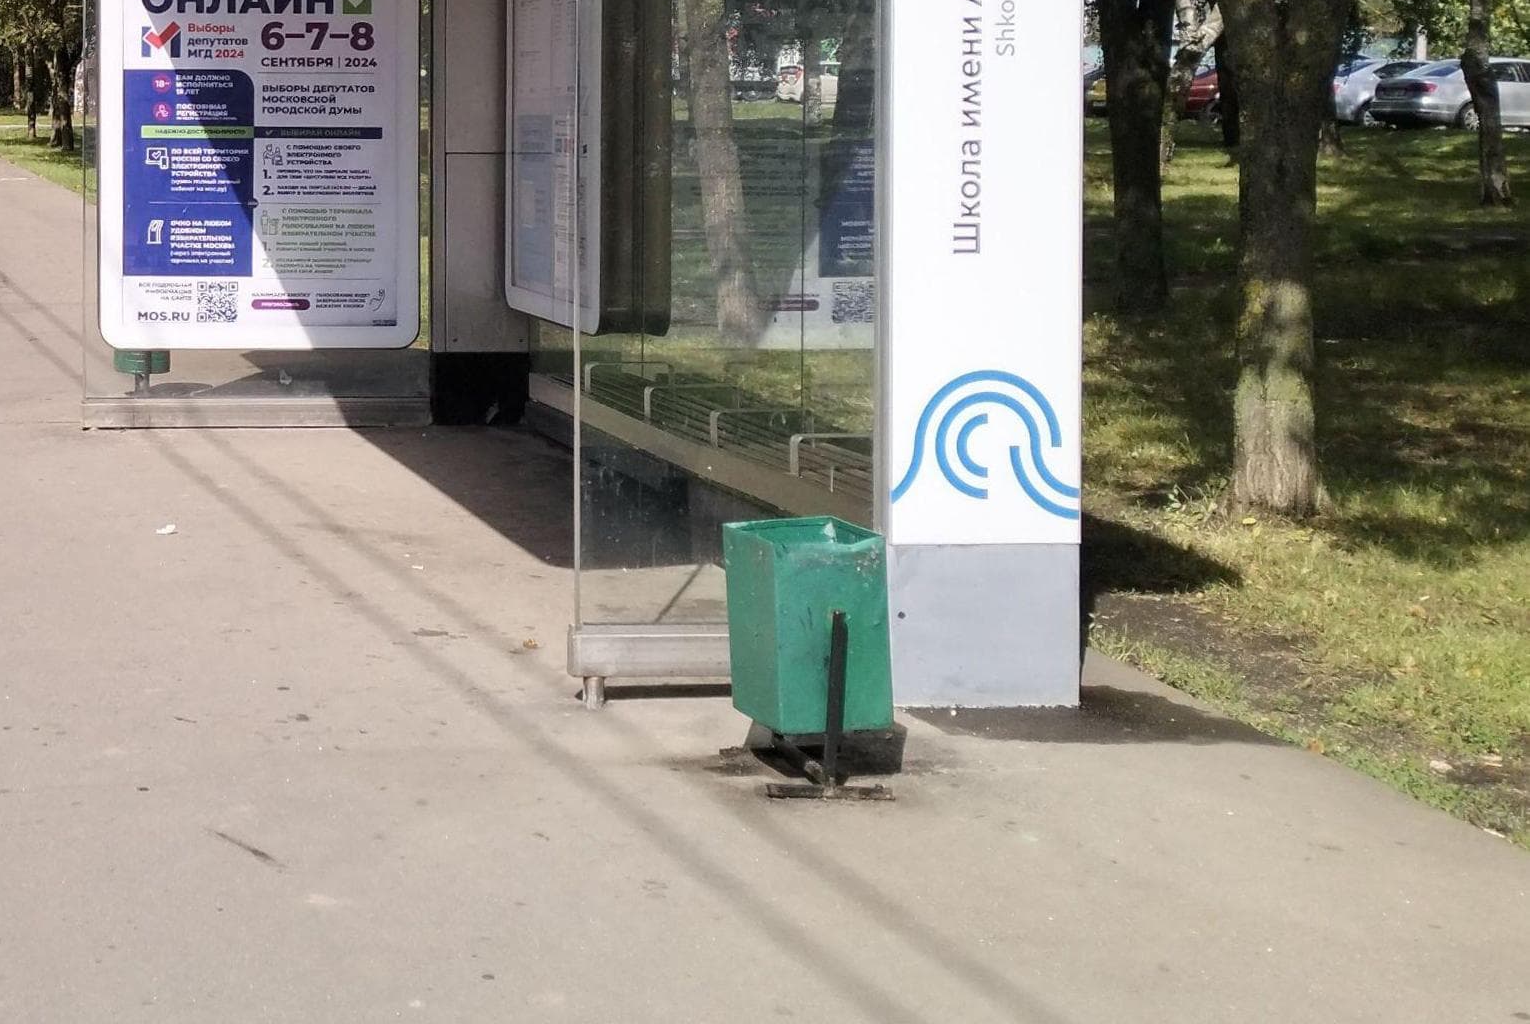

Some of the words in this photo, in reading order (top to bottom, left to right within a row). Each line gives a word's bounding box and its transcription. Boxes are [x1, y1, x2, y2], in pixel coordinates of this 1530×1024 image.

[187, 23, 235, 34] Выборы
[187, 36, 249, 47] депутатов
[187, 49, 214, 59] МГД
[214, 49, 244, 59] 2024
[261, 57, 333, 68] СЕНТЯБРЯ
[344, 57, 378, 68] 2024
[961, 16, 982, 128] имени
[262, 84, 310, 93] ВЫБОРЫ
[312, 84, 375, 94] ДЕПУТАТОВ
[262, 94, 336, 104] МОСКОВСКОЙ
[262, 105, 327, 115] ГОРОДСКОЙ
[328, 106, 362, 116] ДУМЫ
[953, 142, 982, 255] Школа
[137, 311, 190, 321] MOS.RU
